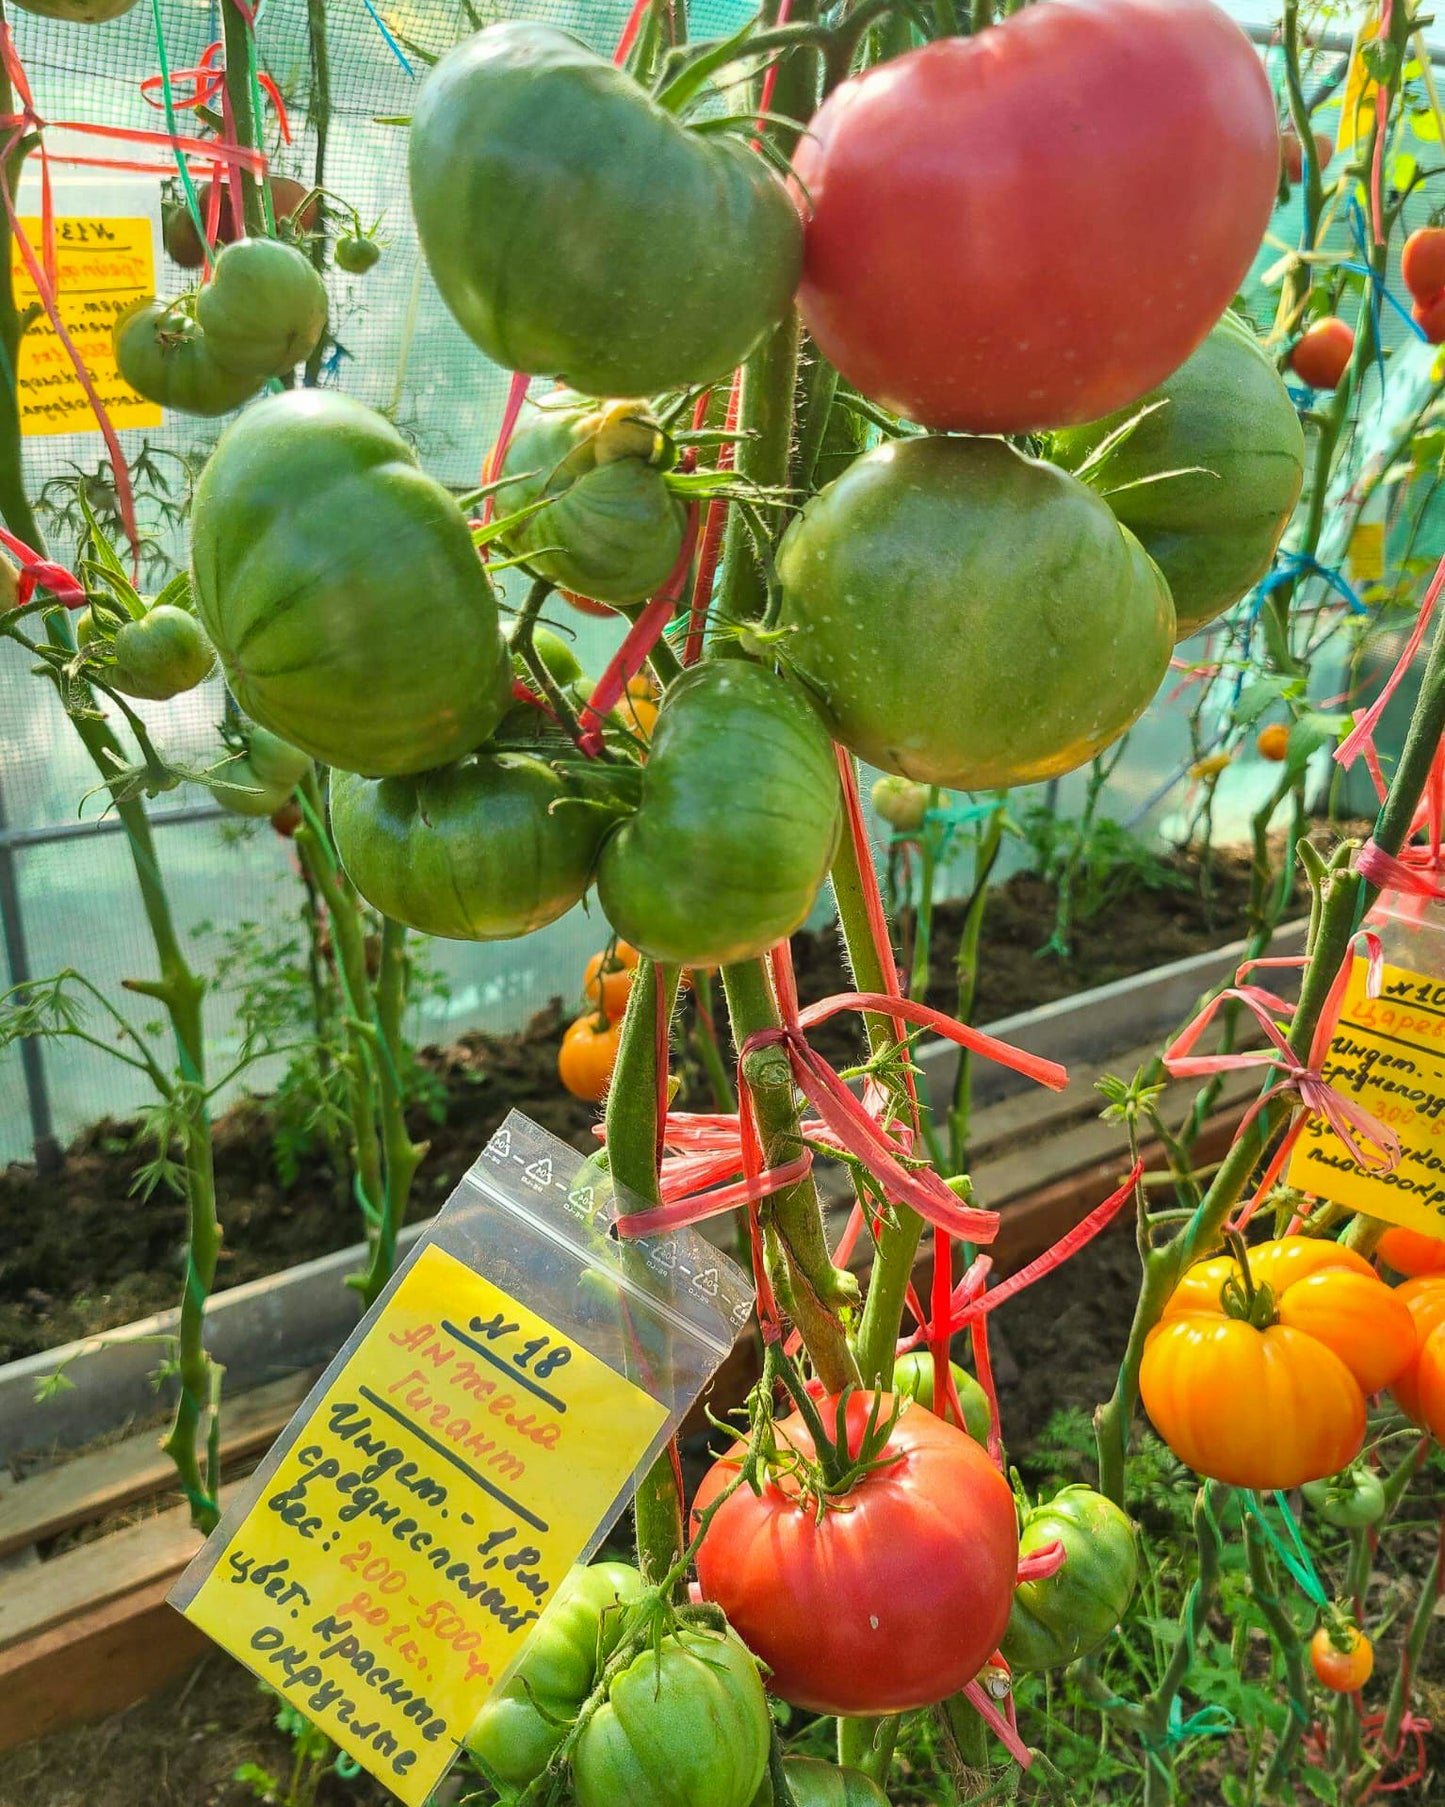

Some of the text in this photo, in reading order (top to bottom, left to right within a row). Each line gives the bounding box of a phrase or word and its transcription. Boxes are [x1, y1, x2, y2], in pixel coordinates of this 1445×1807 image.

[388, 1323, 561, 1451] Анжела
[513, 1336, 572, 1379] 18
[387, 1369, 526, 1481] Гигант
[297, 1445, 540, 1633] среднеспелый
